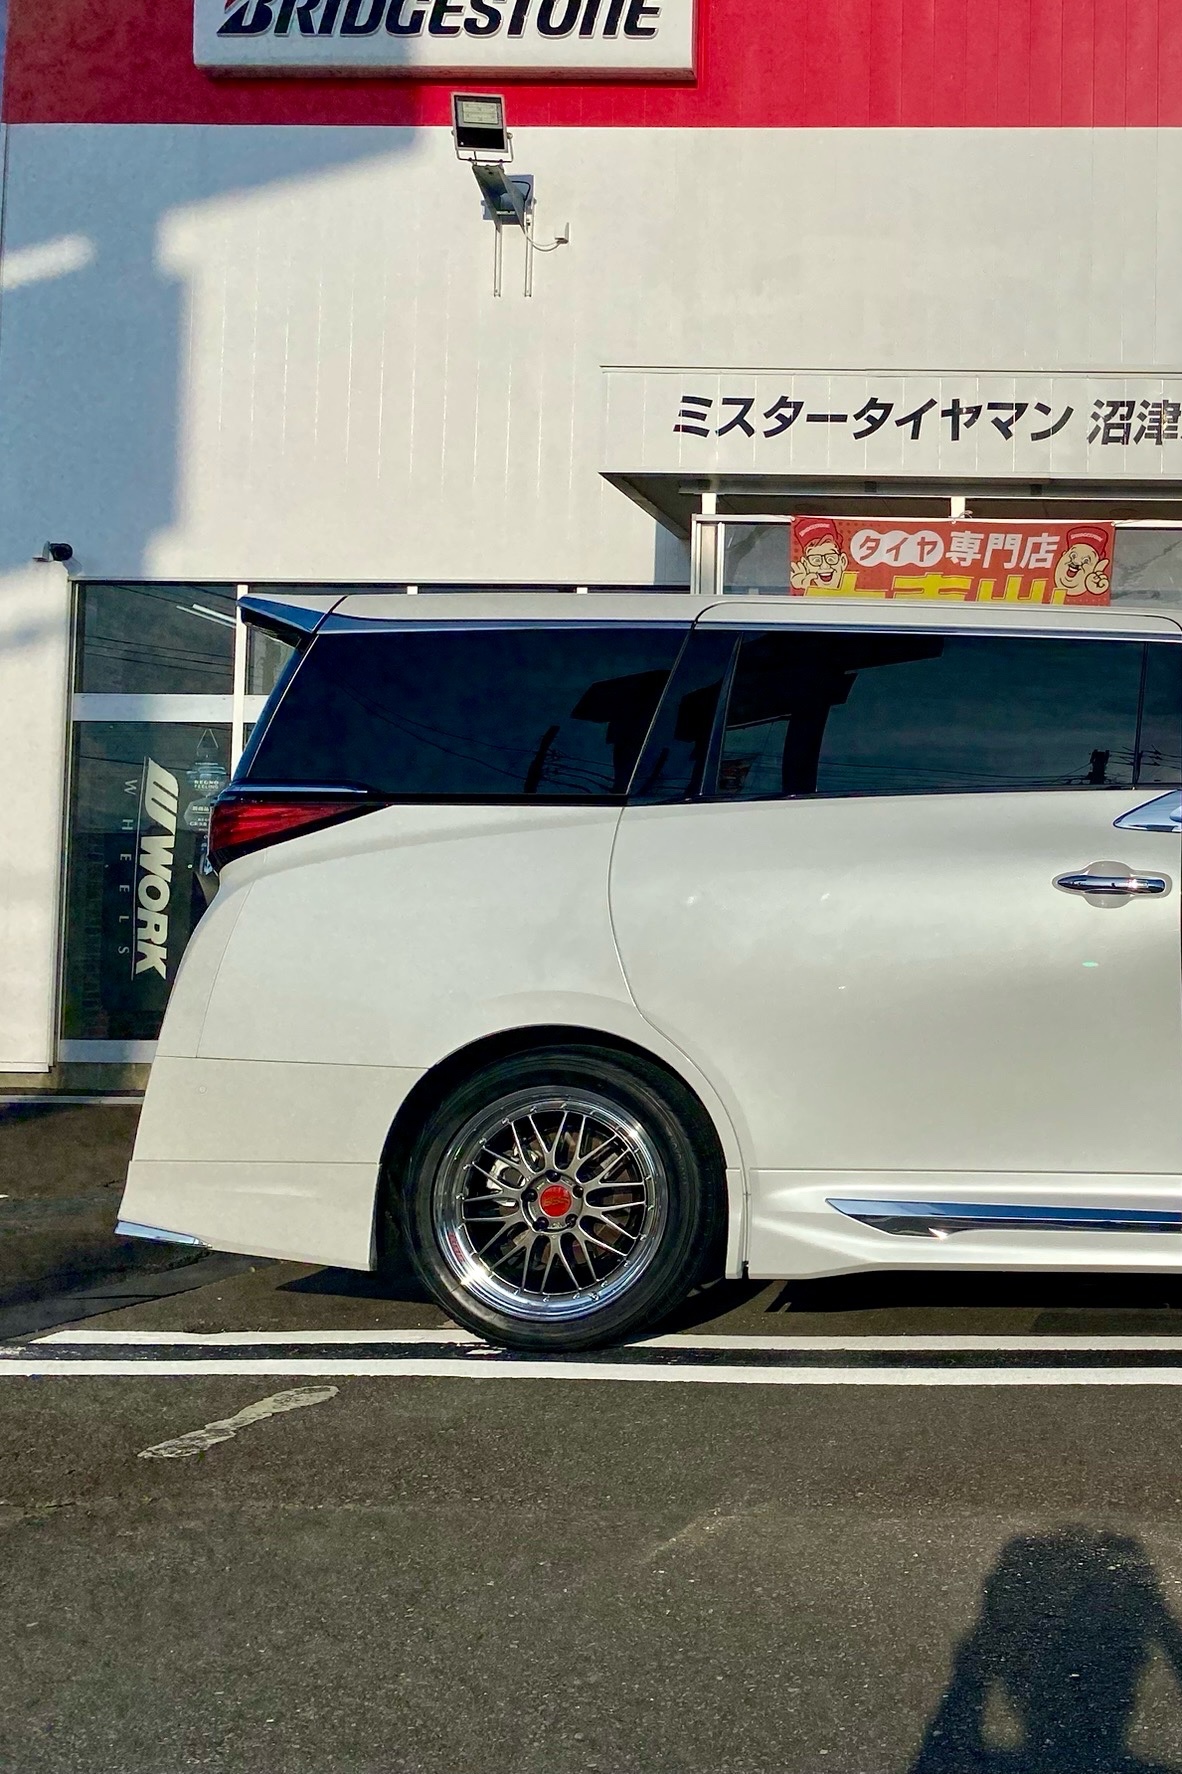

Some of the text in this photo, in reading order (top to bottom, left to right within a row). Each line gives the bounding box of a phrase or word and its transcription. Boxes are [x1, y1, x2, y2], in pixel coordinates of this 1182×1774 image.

[215, 0, 661, 38] BRIDGESTONE
[672, 395, 1075, 441] ミスタータイヤマン
[857, 530, 1060, 569] タイヤ専門店
[117, 778, 138, 955] WHEELS
[135, 834, 176, 980] WORK
